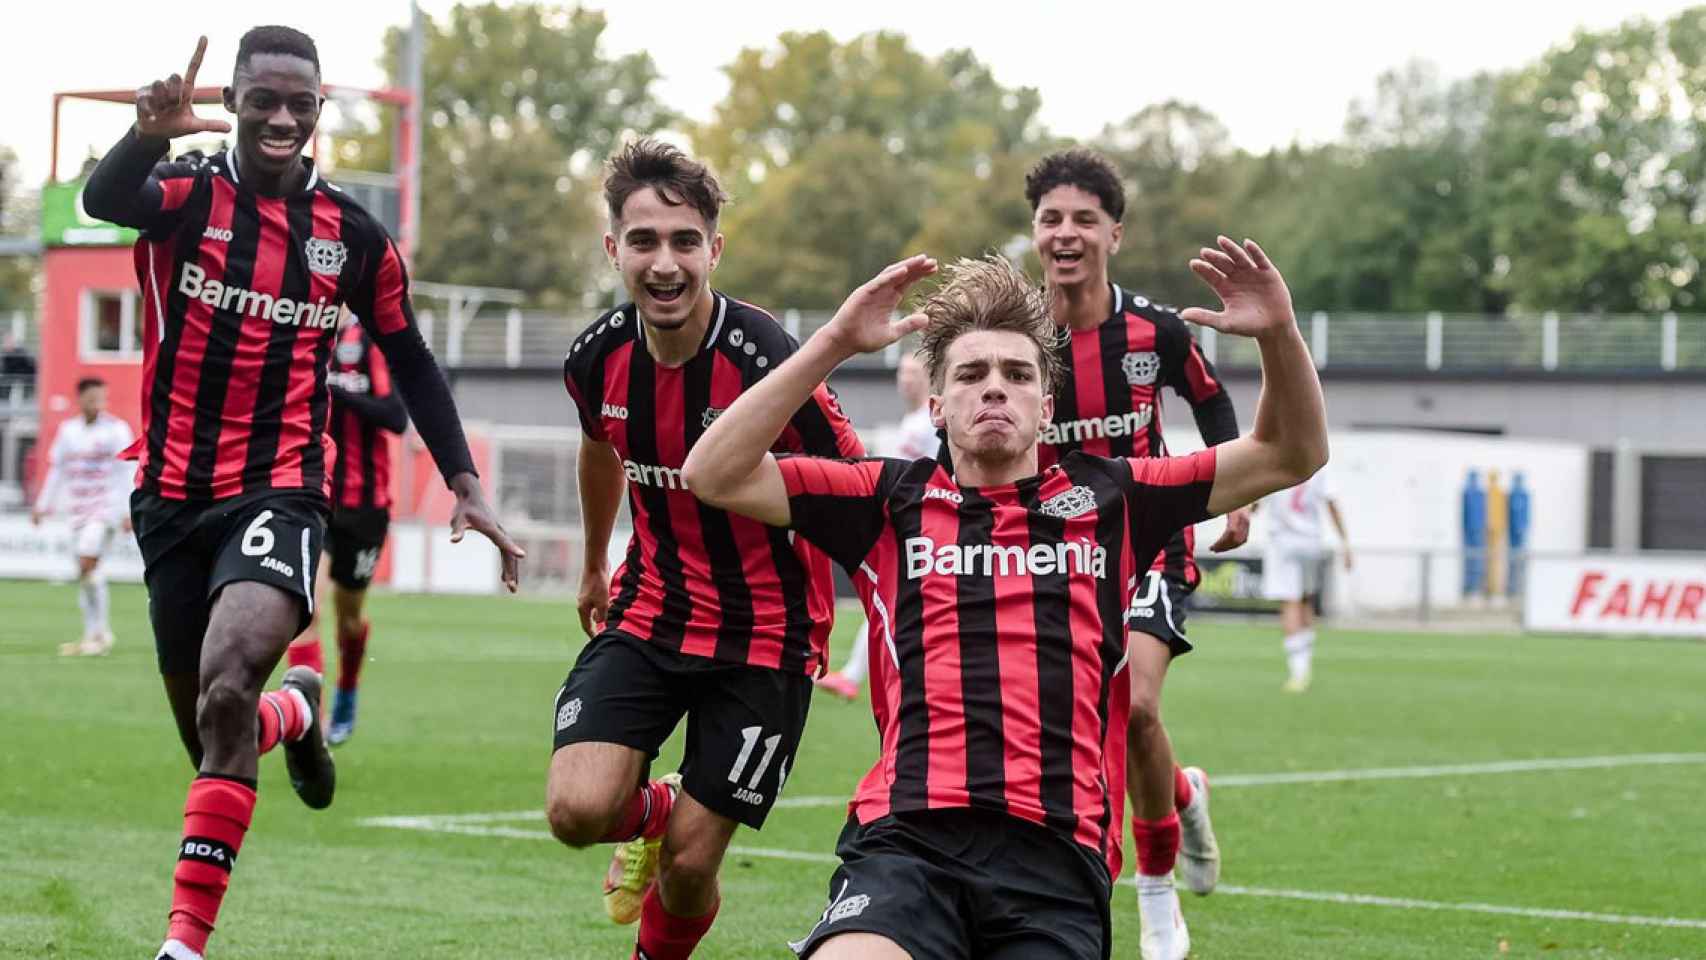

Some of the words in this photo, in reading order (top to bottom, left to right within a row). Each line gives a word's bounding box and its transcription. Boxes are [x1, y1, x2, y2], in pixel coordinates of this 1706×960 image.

[178, 261, 339, 328] Barmenia
[601, 402, 629, 420] JAKO
[241, 509, 275, 556] 6
[260, 556, 294, 578] JAKO
[905, 536, 1107, 580] Barmenia
[727, 726, 782, 790] 11
[731, 787, 763, 805] JAKO
